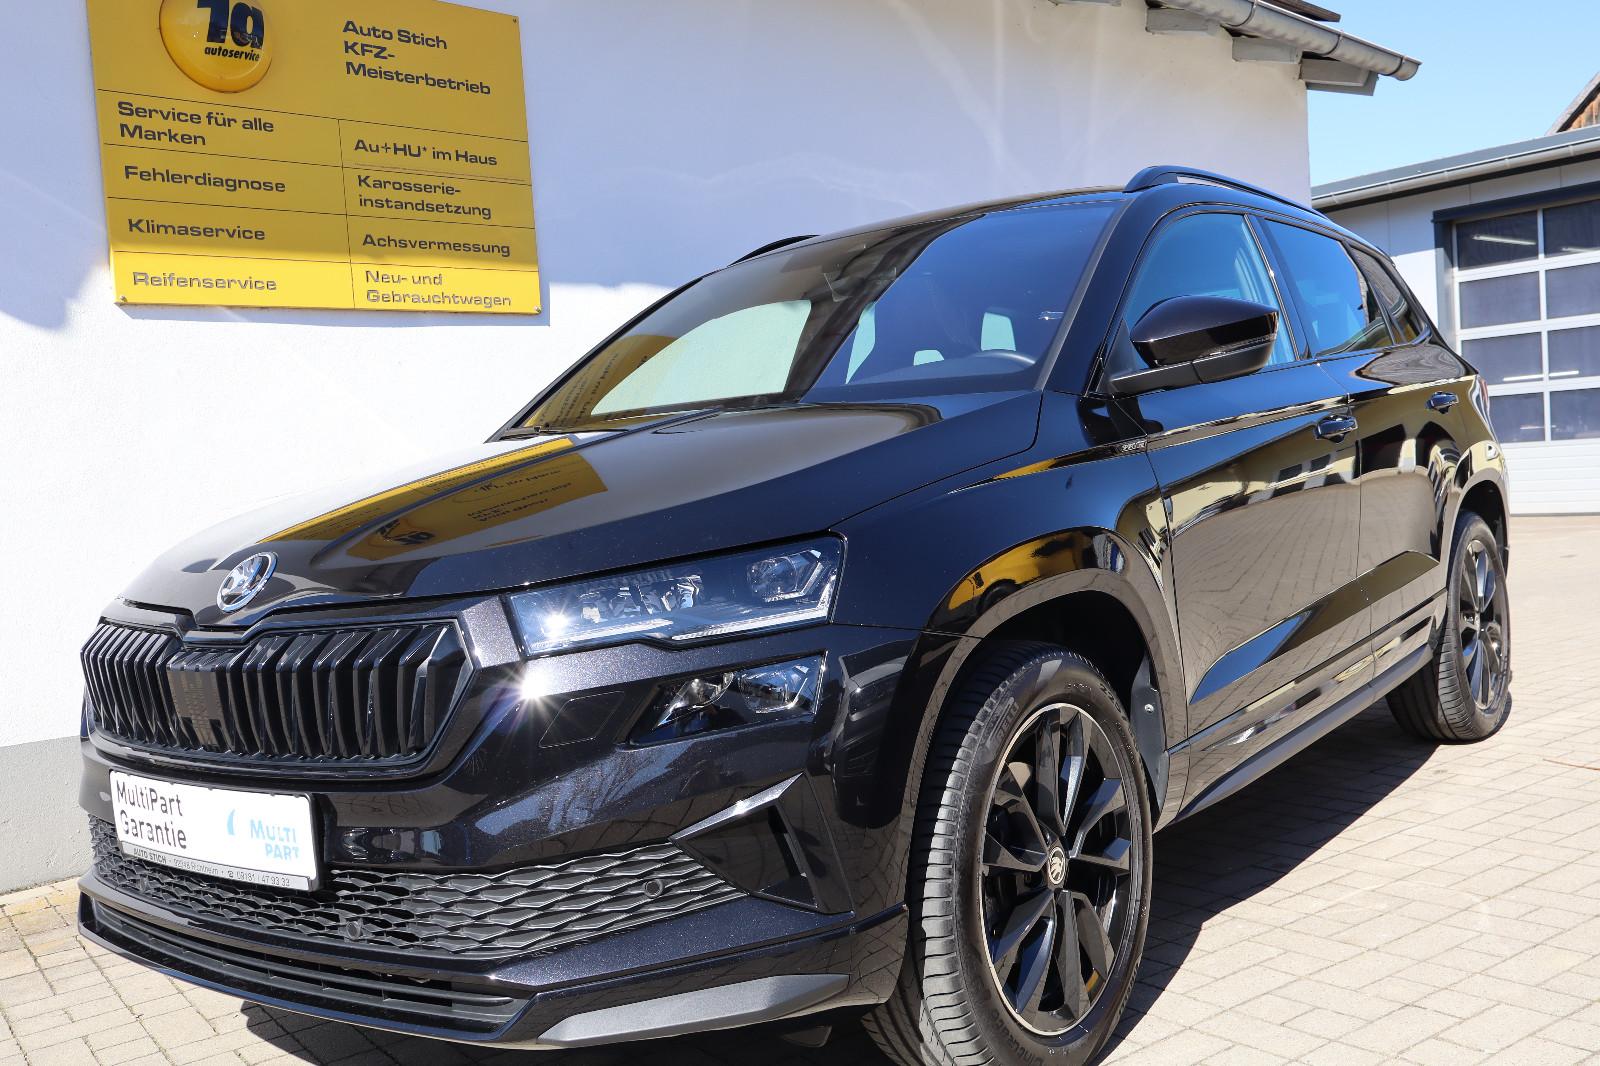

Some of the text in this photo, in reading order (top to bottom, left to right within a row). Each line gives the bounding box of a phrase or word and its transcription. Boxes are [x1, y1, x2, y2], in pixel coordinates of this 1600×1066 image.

[342, 20, 448, 50] Auto Stich
[204, 46, 261, 61] autoservice
[344, 40, 396, 60] KFZ-
[345, 61, 491, 95] Meisterbetrieb
[118, 101, 274, 132] Service für alle
[120, 123, 206, 145] Marken
[432, 147, 452, 161] im
[455, 150, 498, 166] Haus
[124, 165, 286, 192] Fehlerdiagnose
[357, 174, 461, 196] Karosserie-
[358, 194, 492, 220] instandsetzung
[128, 218, 265, 240] Klimaservice
[362, 234, 511, 257] Achsvermessung
[133, 271, 277, 290] Reifenservice
[365, 270, 443, 285] Neu- und
[366, 289, 512, 309] Gebrauchtwagen
[116, 779, 183, 817] MultiPart
[120, 809, 187, 849] Garantie
[133, 847, 149, 858] AUTO
[149, 852, 167, 865] STICH
[264, 842, 300, 861] PART
